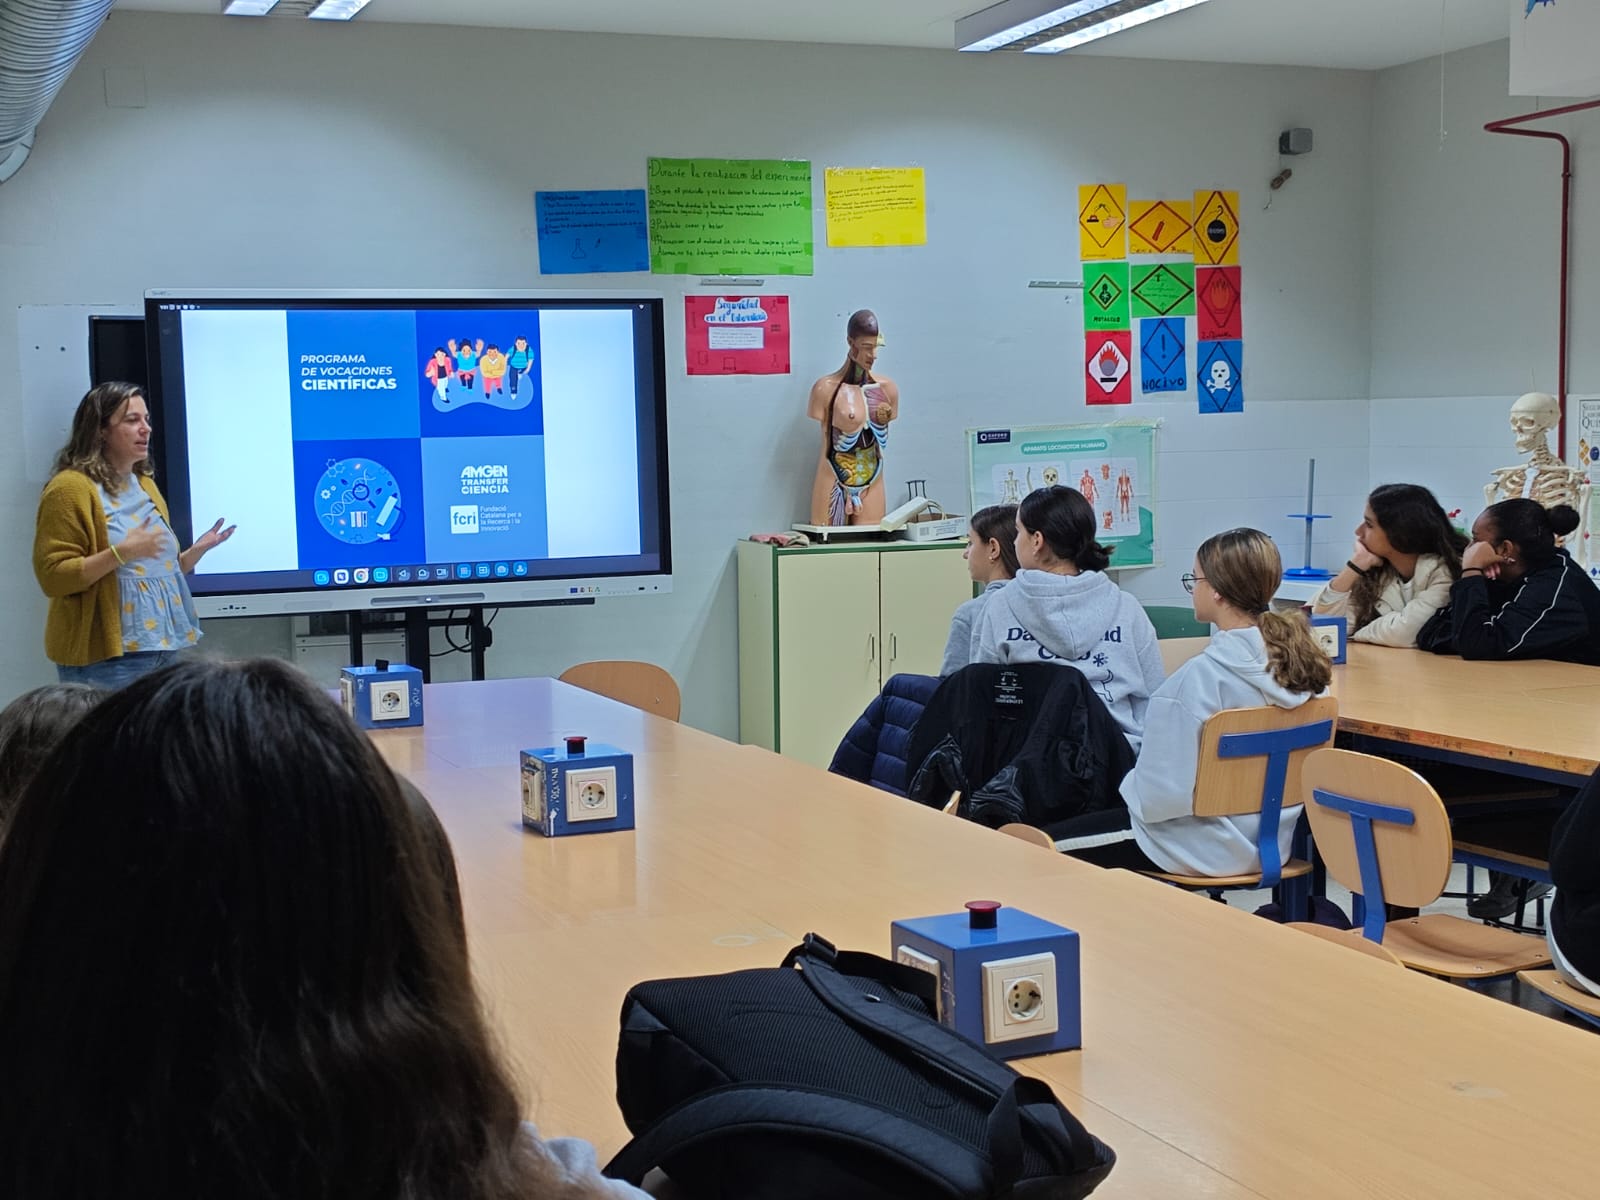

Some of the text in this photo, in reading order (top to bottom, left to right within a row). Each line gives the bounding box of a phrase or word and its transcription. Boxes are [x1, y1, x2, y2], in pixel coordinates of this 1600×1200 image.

[301, 354, 366, 364] PROGRAMA
[301, 366, 393, 376] DE VOCACIONES
[301, 375, 398, 391] CIENTÍFICAS
[460, 464, 508, 478] AMGEN
[460, 478, 508, 486] TRANSFER
[461, 485, 509, 495] CIENCIA
[453, 511, 476, 525] fcri
